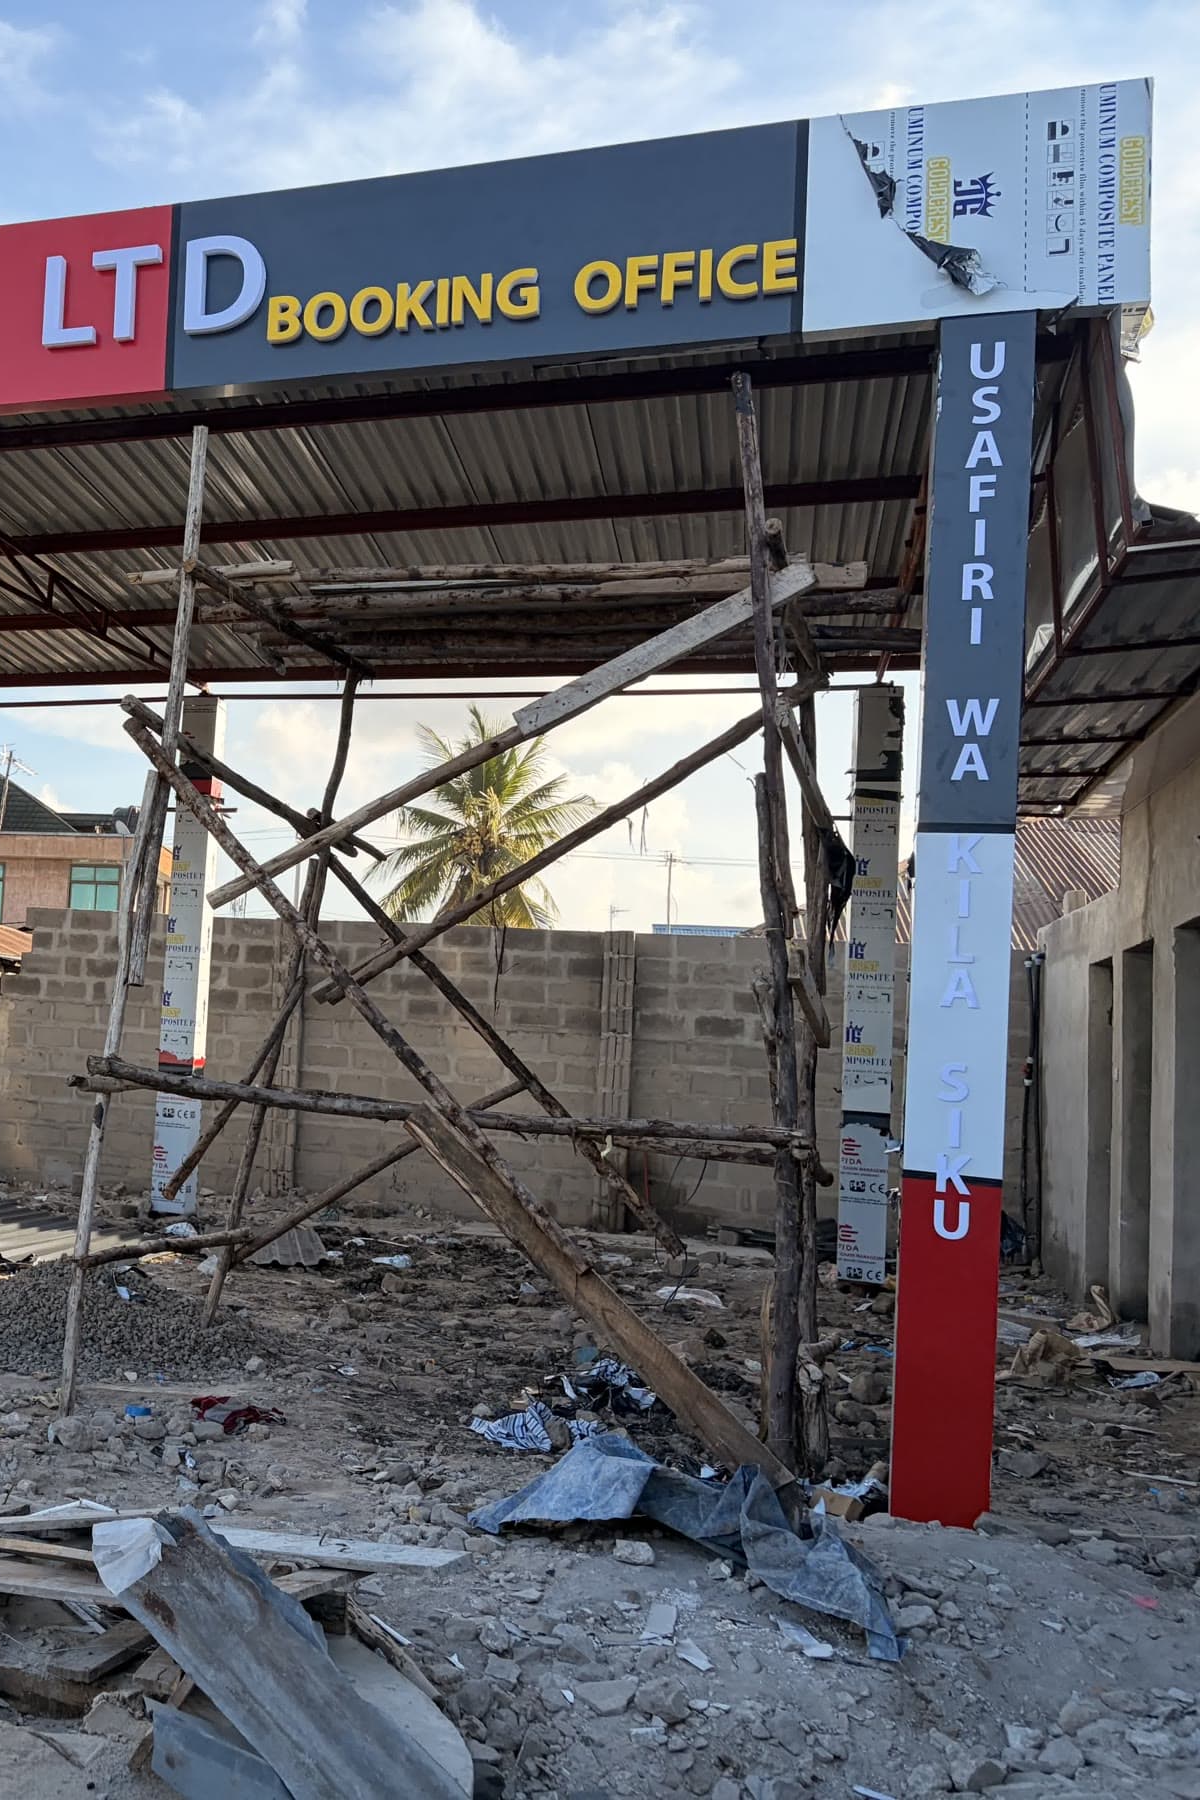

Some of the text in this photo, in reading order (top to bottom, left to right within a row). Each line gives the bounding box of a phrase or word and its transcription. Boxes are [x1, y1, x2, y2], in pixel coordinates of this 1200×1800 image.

[1098, 154, 1116, 248] COMPOSITE
[1120, 136, 1145, 226] GOLDCREST
[41, 234, 267, 349] LTD
[266, 238, 798, 345] BOOKING OFFICE
[1097, 254, 1115, 305] PANEL
[933, 340, 1007, 1241] USAFIRI WA KILA SIKU
